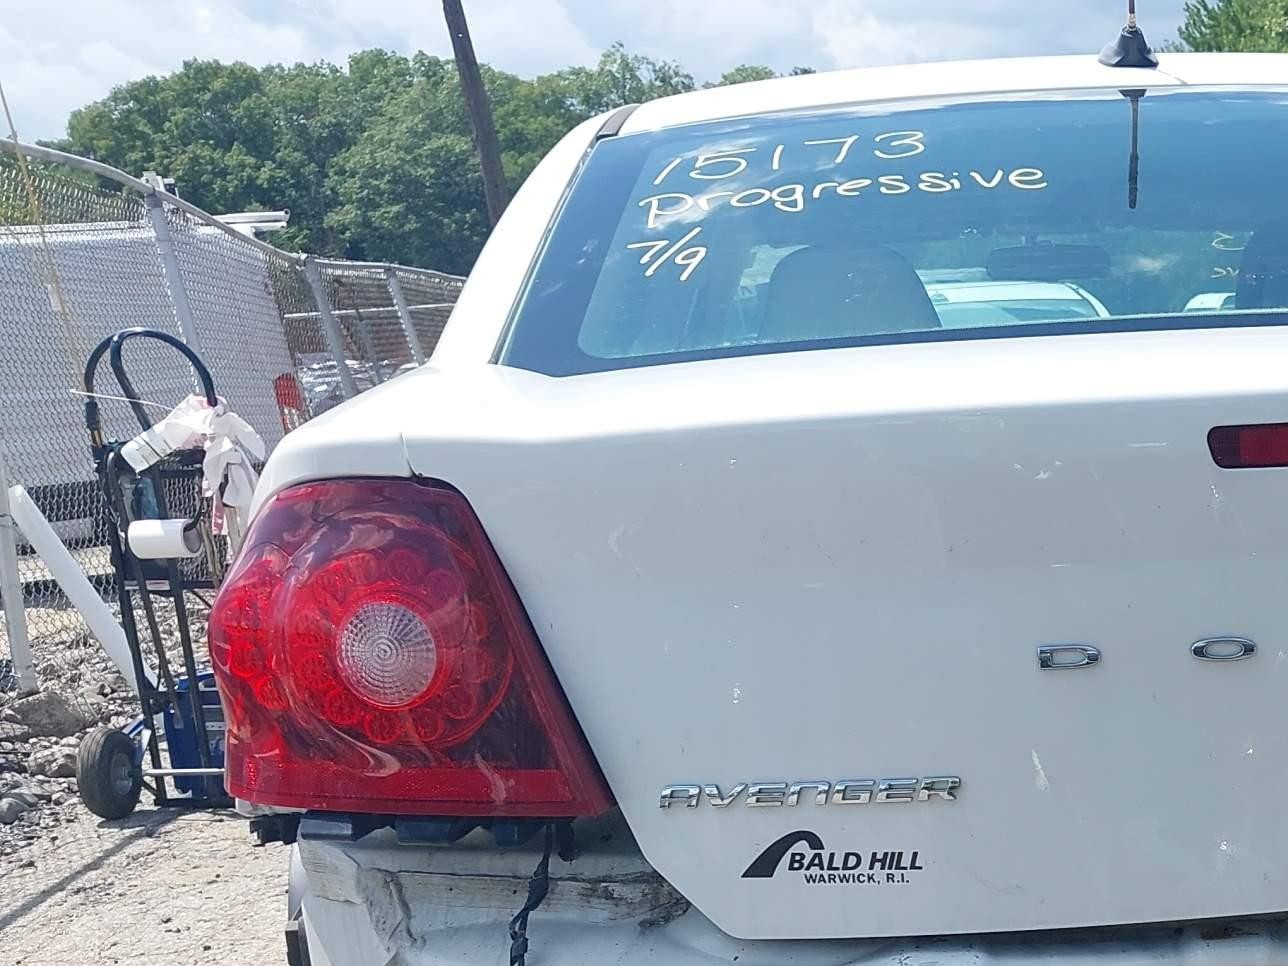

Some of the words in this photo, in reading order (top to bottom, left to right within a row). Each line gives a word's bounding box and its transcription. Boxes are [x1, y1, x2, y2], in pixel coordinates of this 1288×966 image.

[653, 131, 926, 185] 15173
[626, 227, 708, 281] 7/9
[660, 776, 961, 808] AVENGER
[787, 851, 862, 872] BALD
[868, 851, 923, 871] HILL
[804, 873, 881, 885] WARWICK,
[886, 872, 910, 884] R.I.
